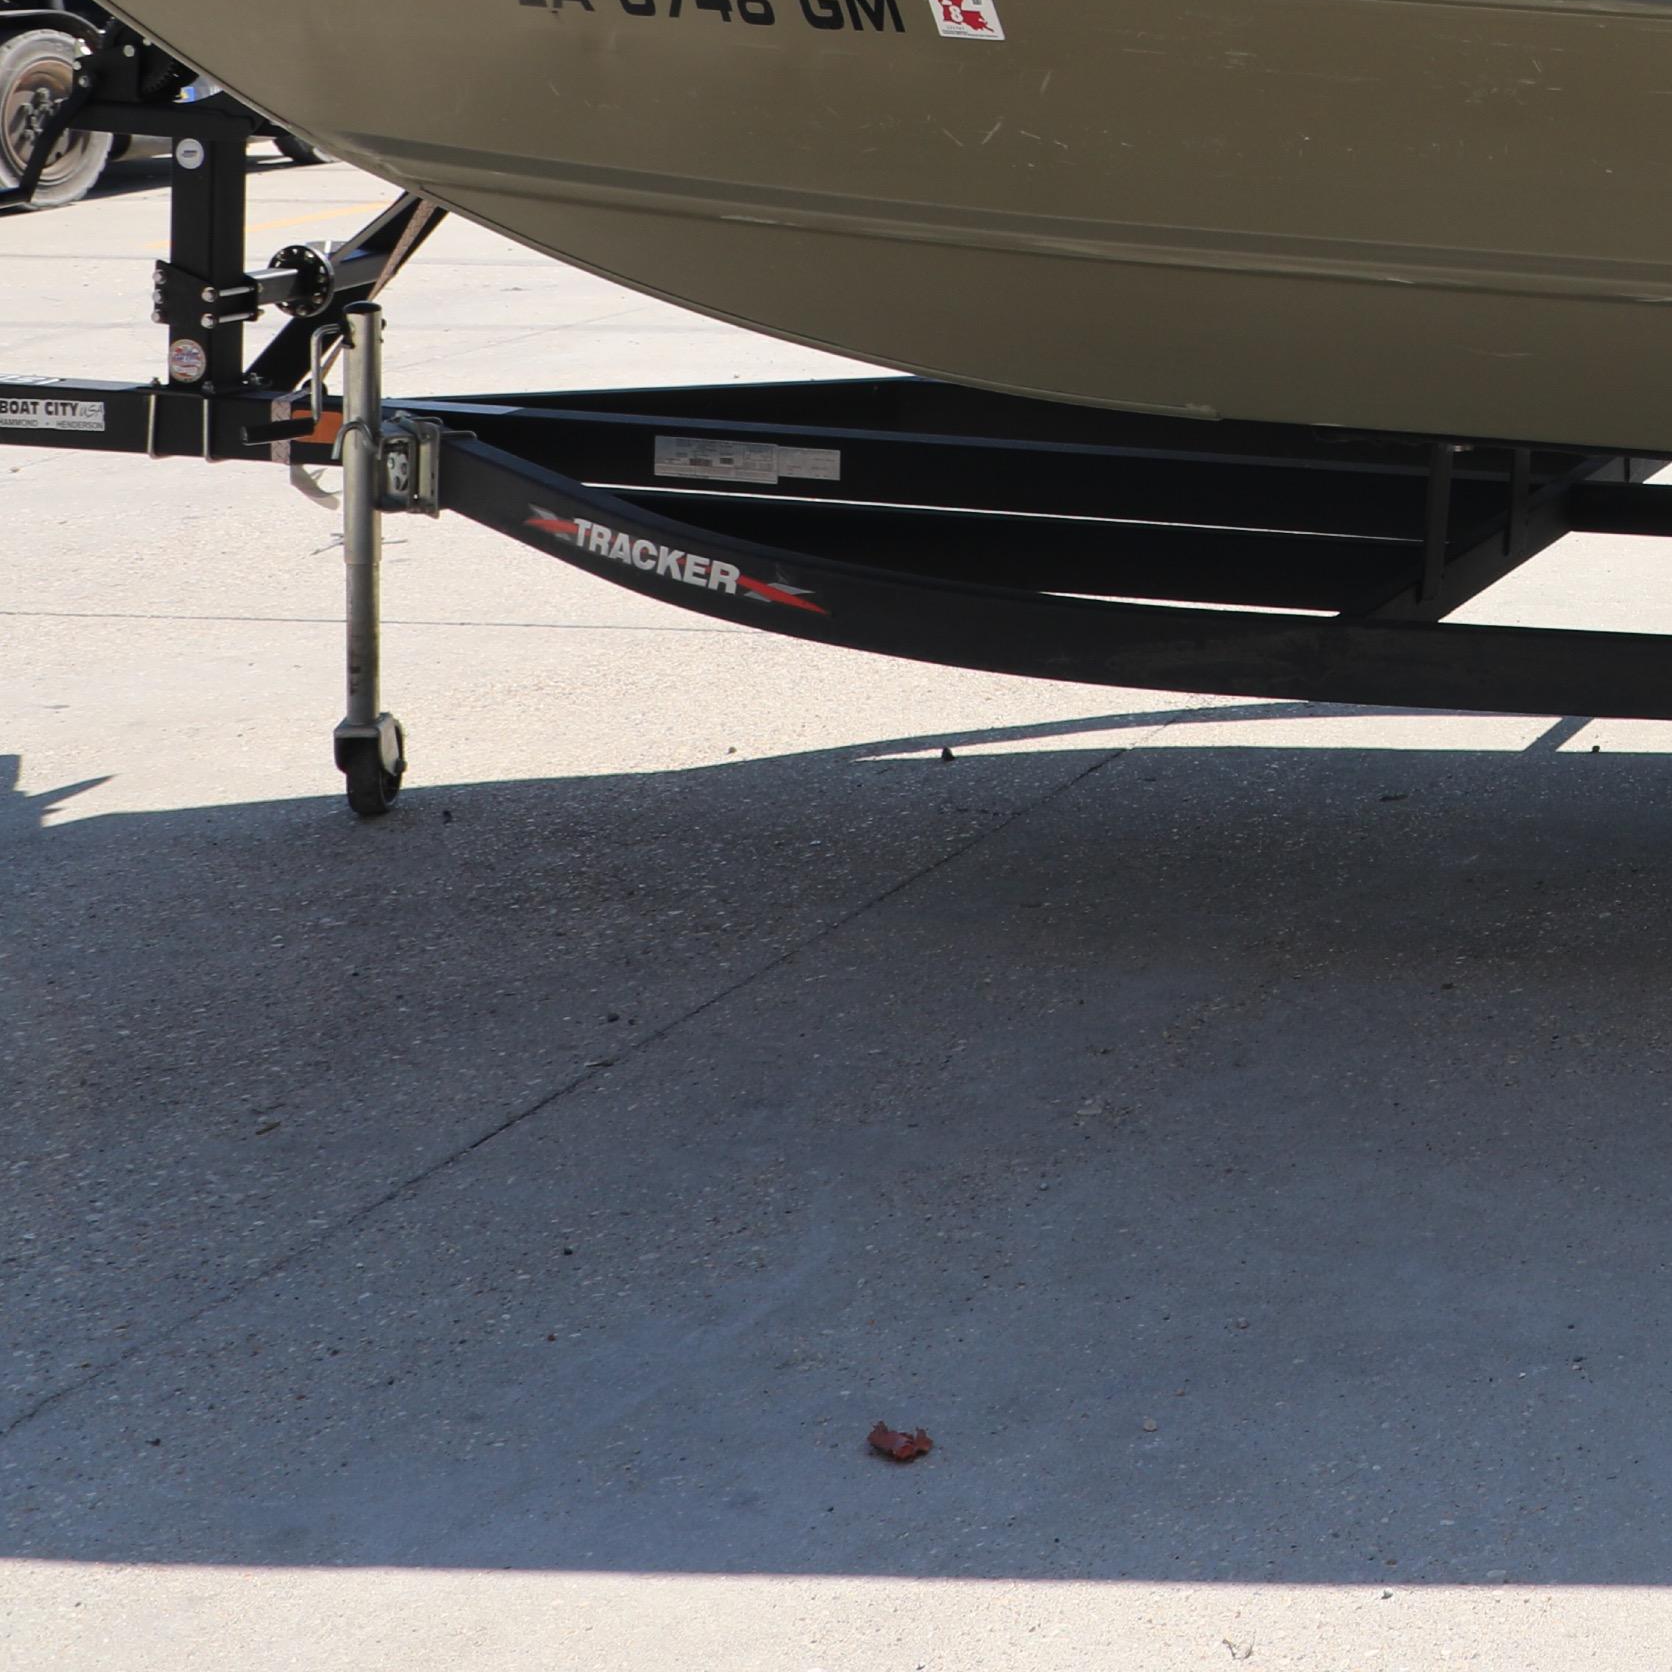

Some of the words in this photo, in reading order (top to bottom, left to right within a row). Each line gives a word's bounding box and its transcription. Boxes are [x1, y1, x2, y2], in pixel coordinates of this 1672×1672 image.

[0, 400, 39, 415] BOAT
[44, 401, 79, 417] CITY
[573, 517, 741, 595] TRACKER
